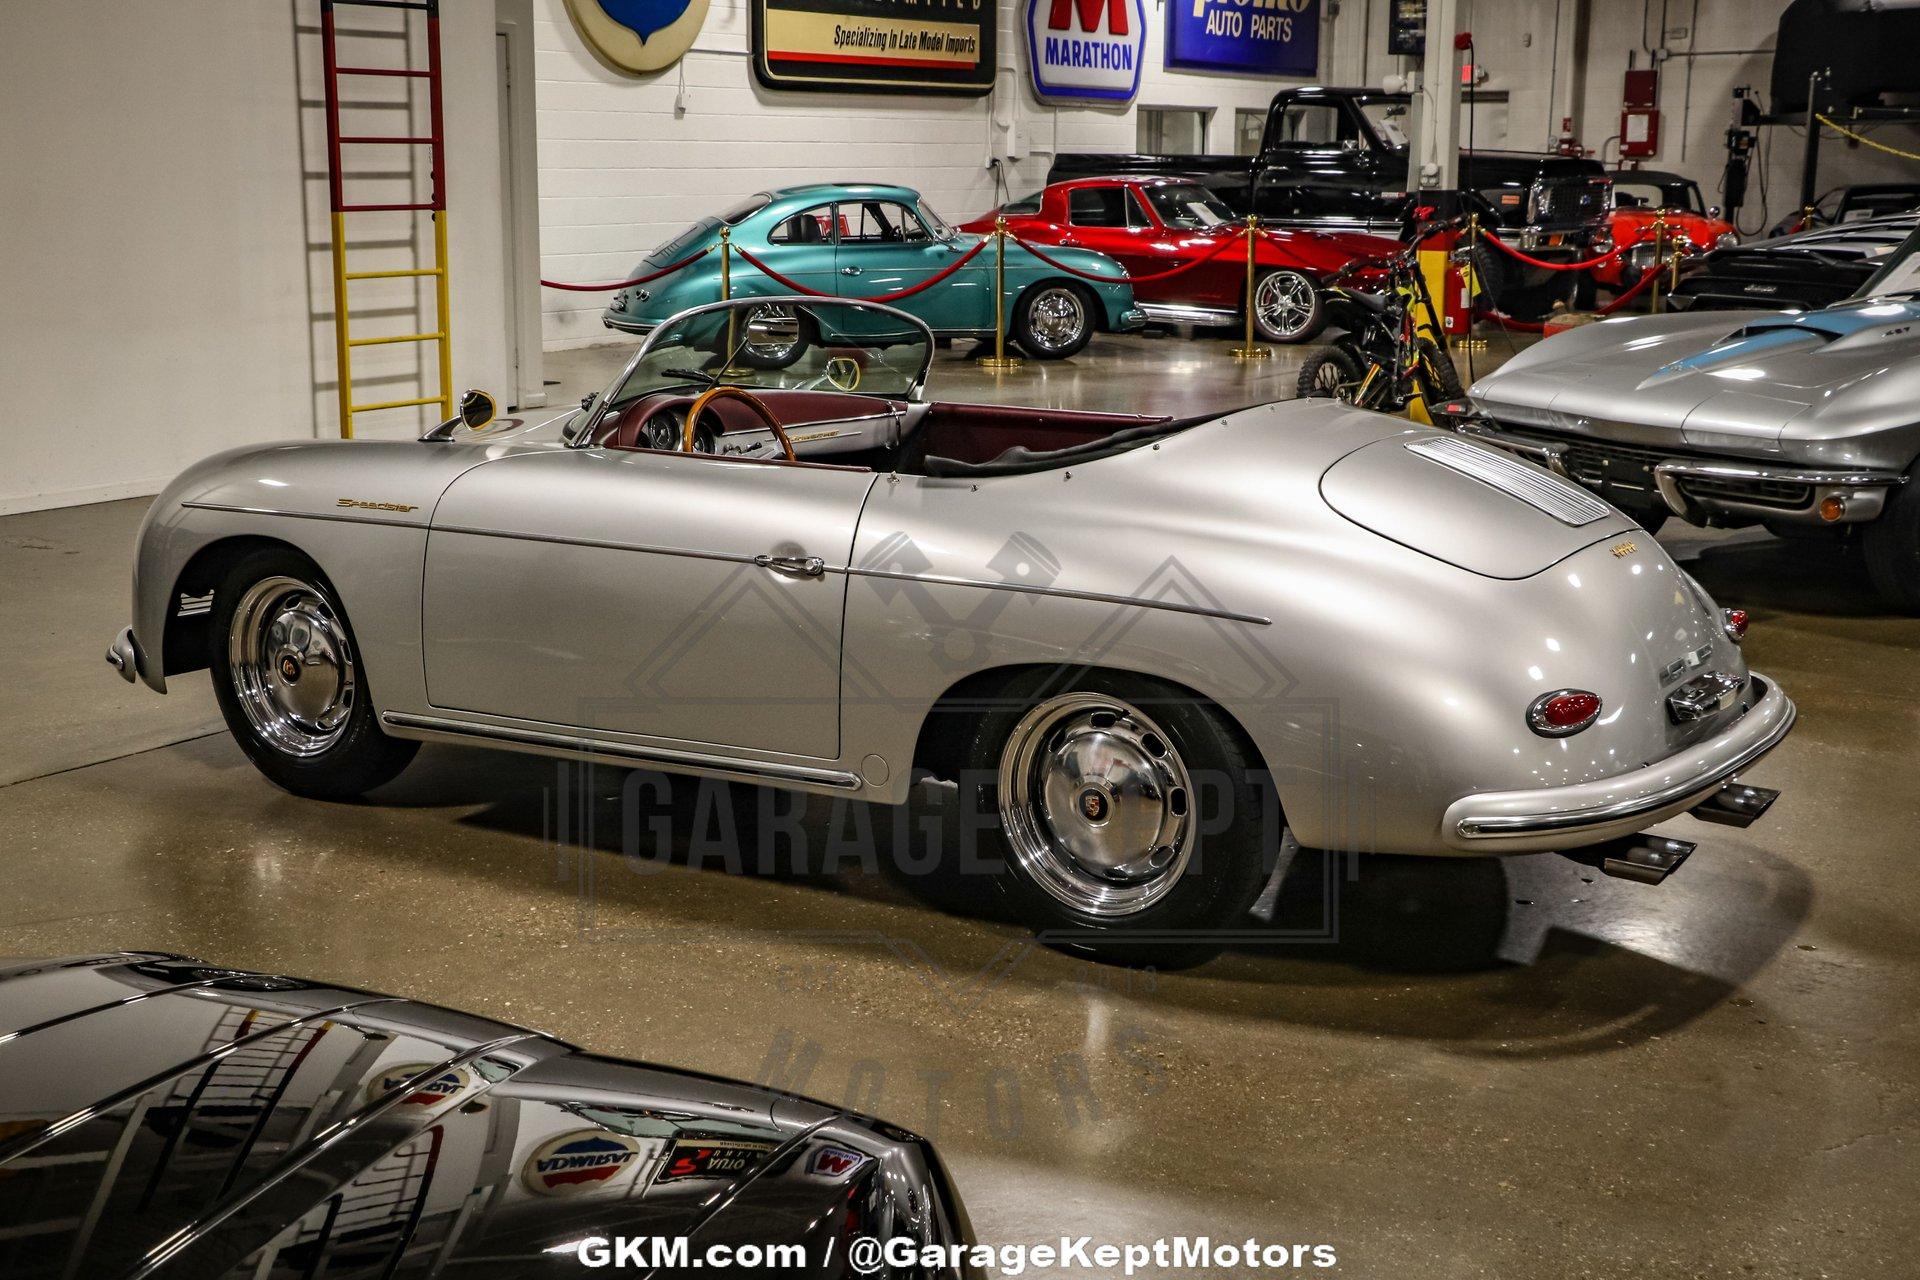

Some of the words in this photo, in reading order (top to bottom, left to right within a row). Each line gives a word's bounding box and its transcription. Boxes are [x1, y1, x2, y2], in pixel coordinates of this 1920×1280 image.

[834, 24, 892, 52] Specializing
[888, 31, 899, 48] In
[899, 31, 917, 49] Late
[919, 31, 944, 51] Model
[945, 33, 976, 55] Imports
[1205, 9, 1243, 38] AUTO
[1250, 14, 1292, 42] PARTS
[1045, 37, 1132, 71] MARATHON
